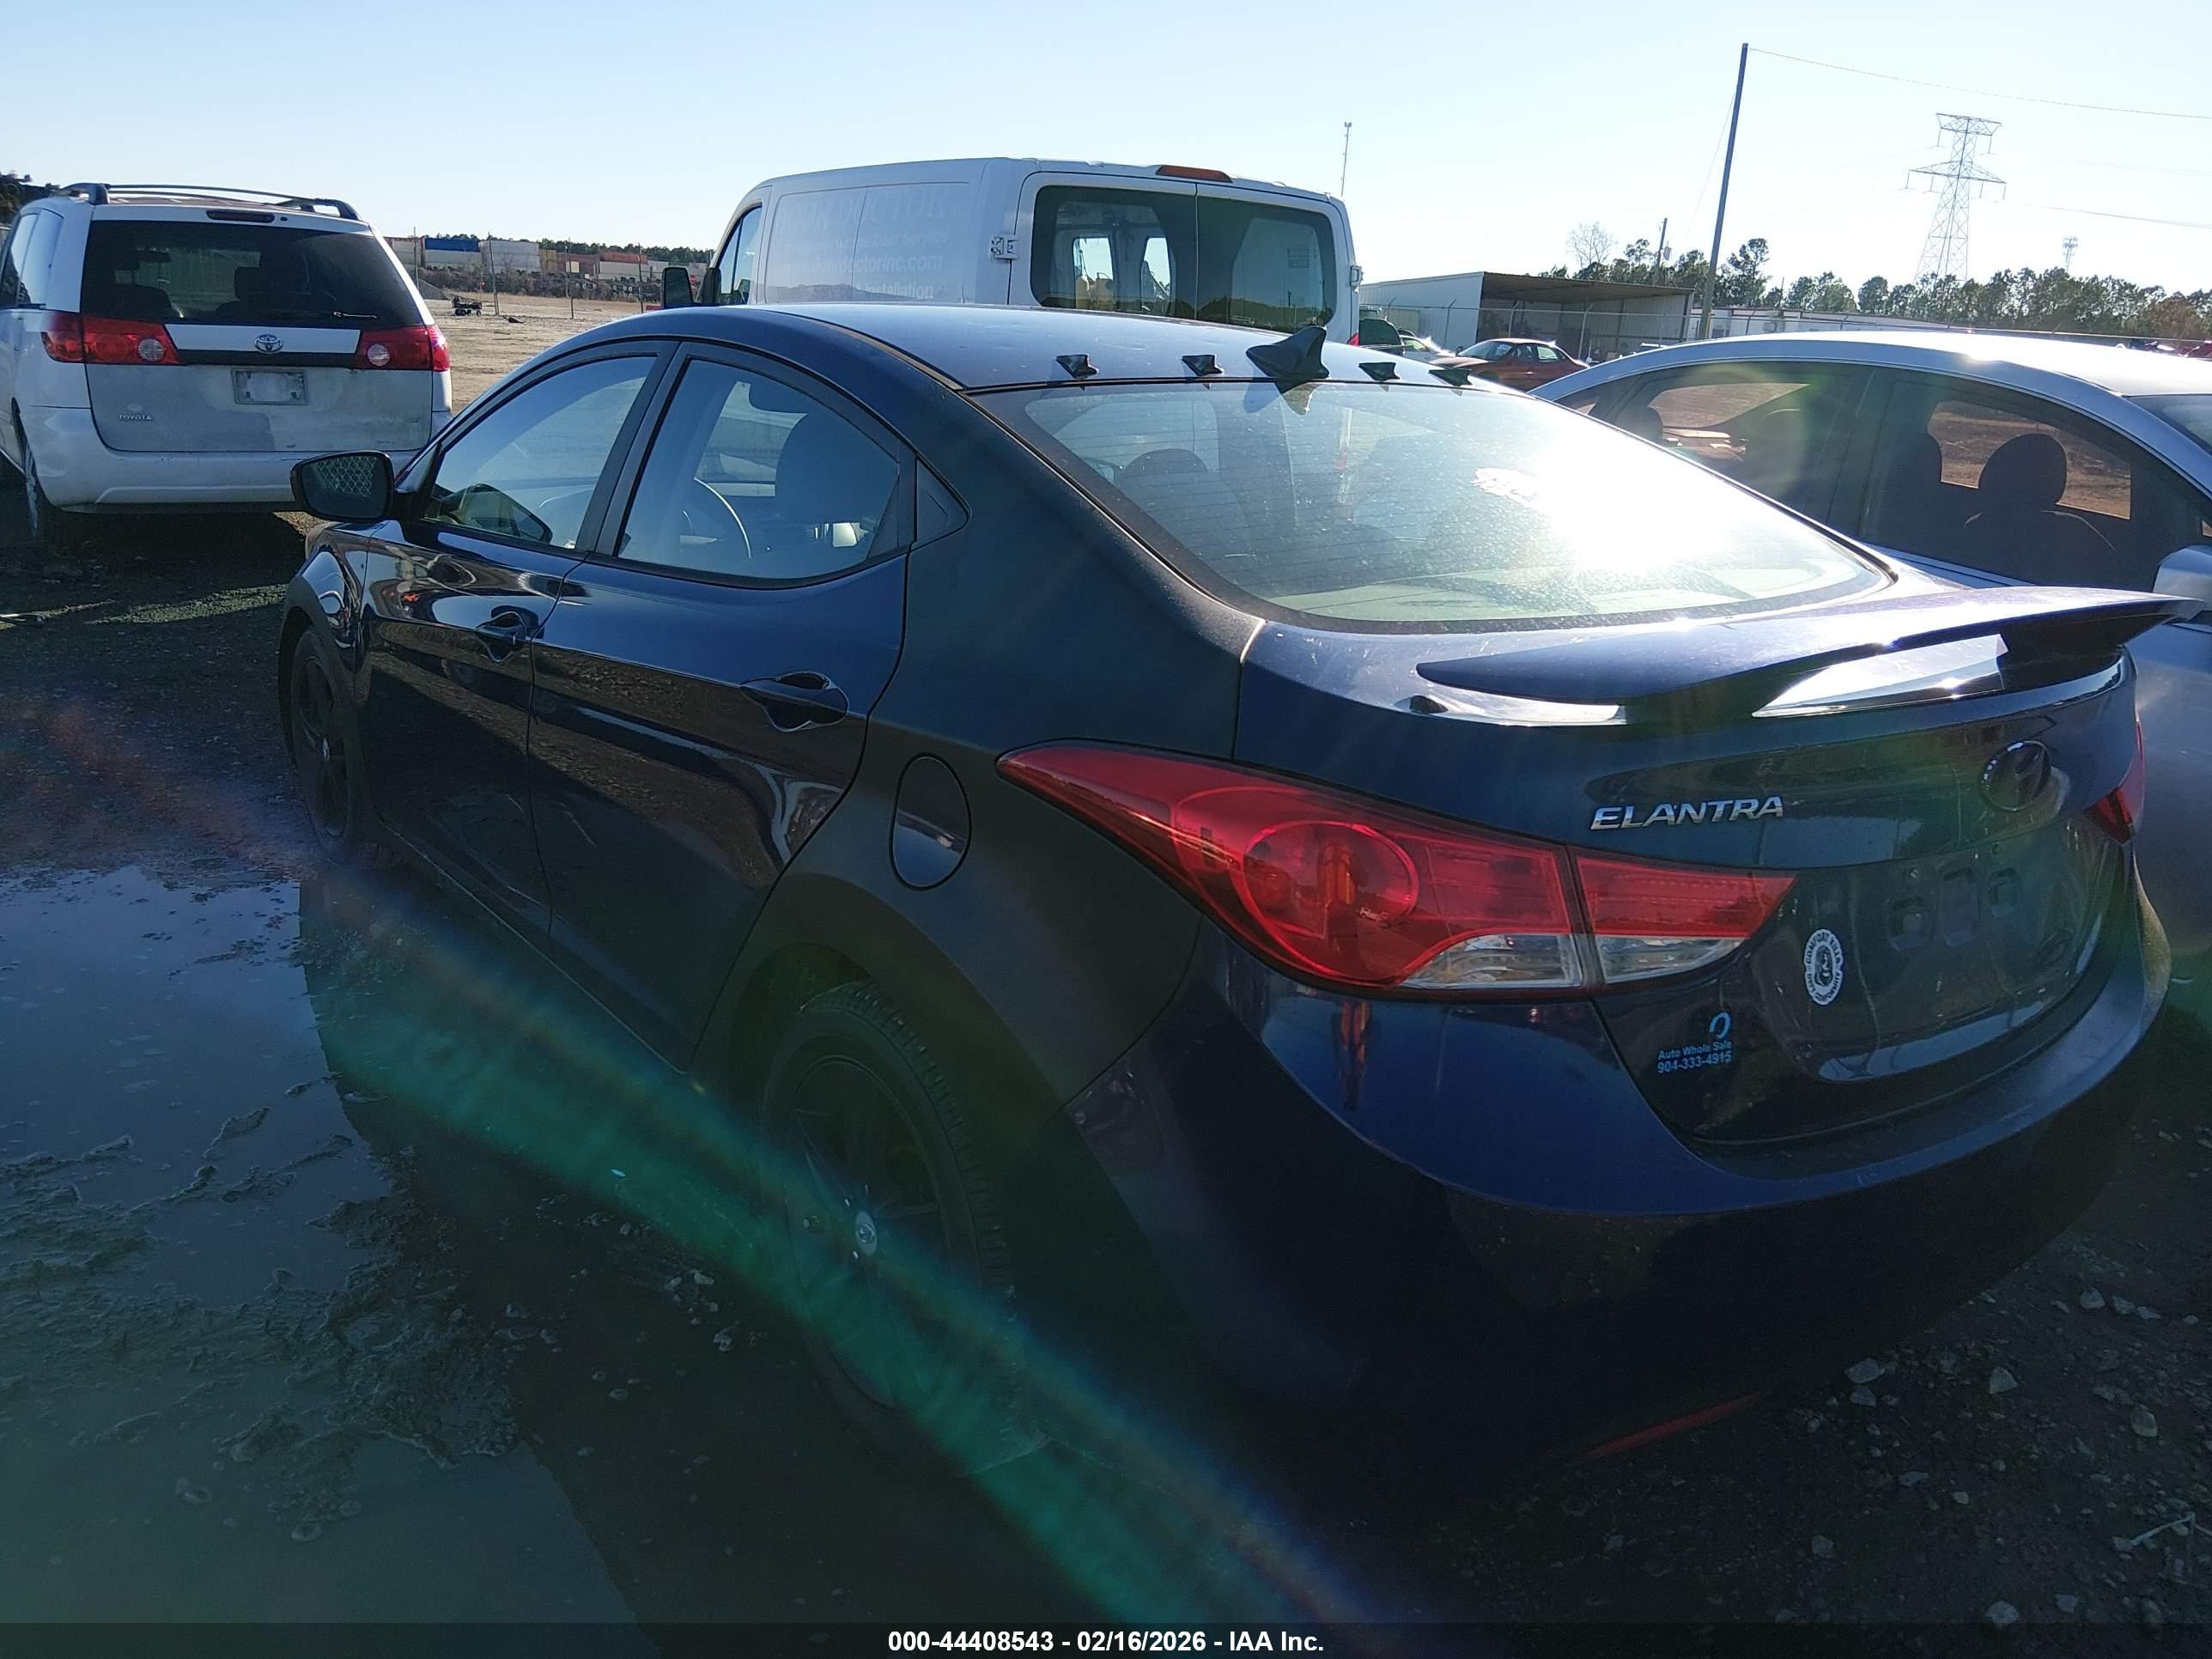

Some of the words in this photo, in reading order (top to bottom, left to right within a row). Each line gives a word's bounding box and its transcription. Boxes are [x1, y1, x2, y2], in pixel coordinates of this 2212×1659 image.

[1590, 796, 1784, 830] ELANTRA
[1658, 1049, 1680, 1060] Auto
[1682, 1044, 1711, 1056] Whole
[1712, 1040, 1732, 1052] Sale
[1657, 1051, 1732, 1073] 904-333-4915
